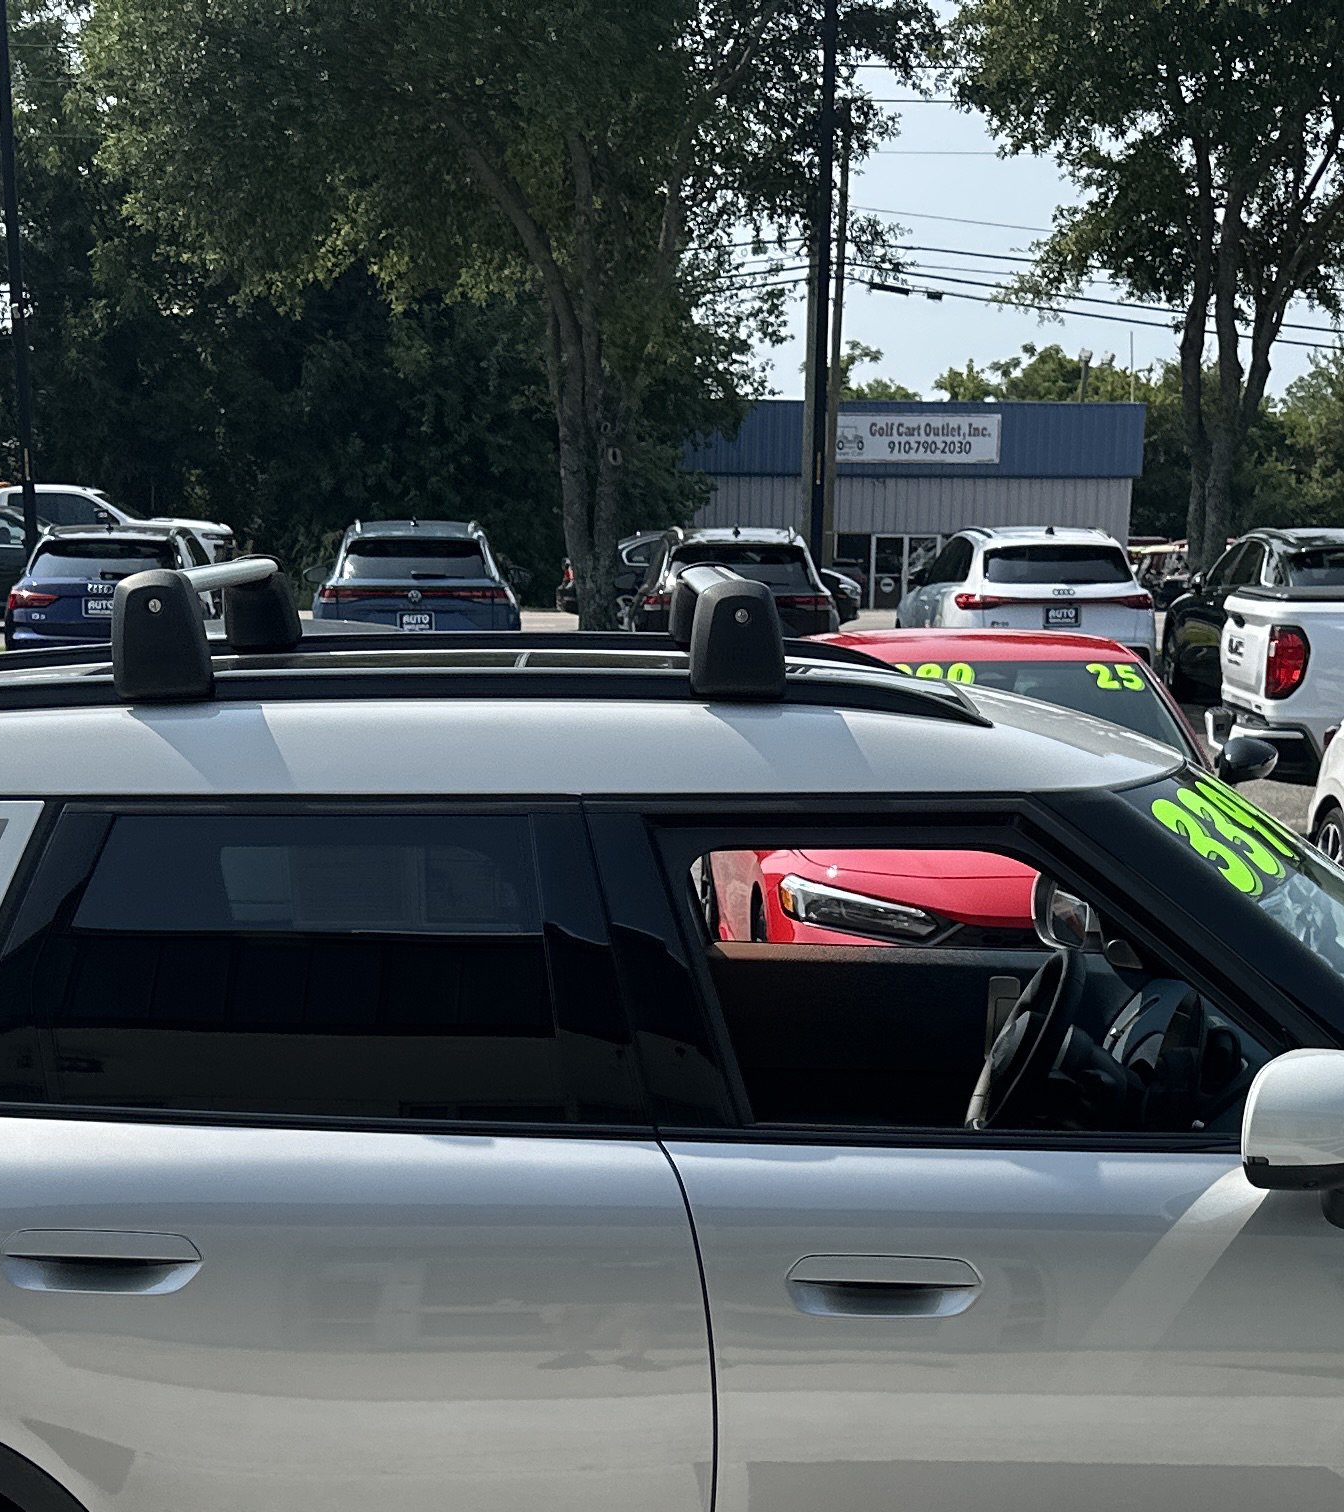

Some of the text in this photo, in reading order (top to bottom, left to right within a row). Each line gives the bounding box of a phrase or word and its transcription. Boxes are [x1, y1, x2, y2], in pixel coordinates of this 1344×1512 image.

[869, 422, 992, 440] Golf Cart Outlet, Inc.
[887, 440, 972, 455] 910-790-2030
[402, 614, 430, 624] AUTO
[1048, 608, 1075, 618] AUTO
[1085, 663, 1145, 691] 25
